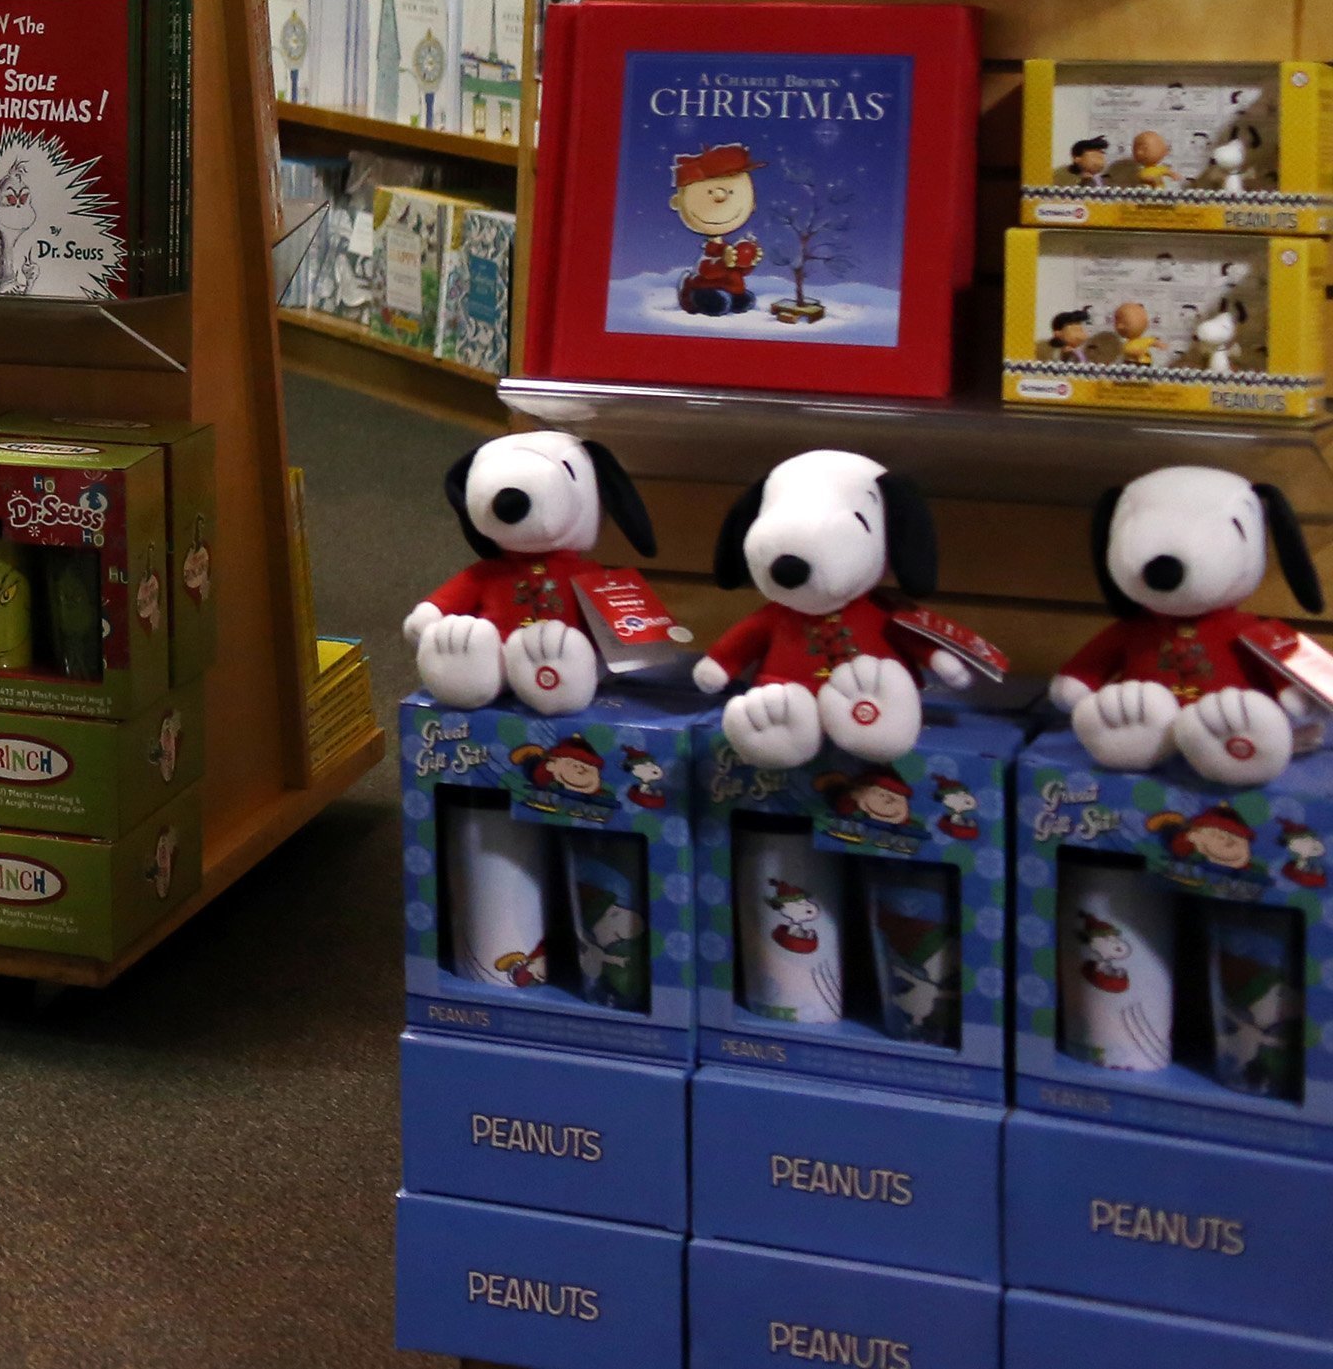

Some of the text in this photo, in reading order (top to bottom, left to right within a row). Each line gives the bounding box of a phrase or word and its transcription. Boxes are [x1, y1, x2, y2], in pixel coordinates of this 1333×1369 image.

[14, 16, 45, 34] The
[4, 68, 57, 92] STOLE
[699, 72, 710, 86] A
[650, 88, 886, 120] CHRISTMAS
[1224, 211, 1298, 230] PEANUTS
[37, 240, 103, 261] Dr. Seuss
[1209, 390, 1286, 412] PEANUTS
[33, 477, 55, 492] HO
[82, 530, 105, 547] HO
[421, 720, 469, 749] Great
[415, 749, 449, 777] Gift
[429, 1005, 490, 1027] PEANUTS
[721, 1038, 786, 1062] PEANUTS
[1041, 1087, 1111, 1114] PEANUTS
[473, 1114, 602, 1162] PEANUTS
[771, 1154, 914, 1206] PEANUTS
[1091, 1199, 1245, 1256] PEANUTS
[468, 1270, 599, 1322] PEANUTS
[769, 1321, 911, 1369] PEANUTS
